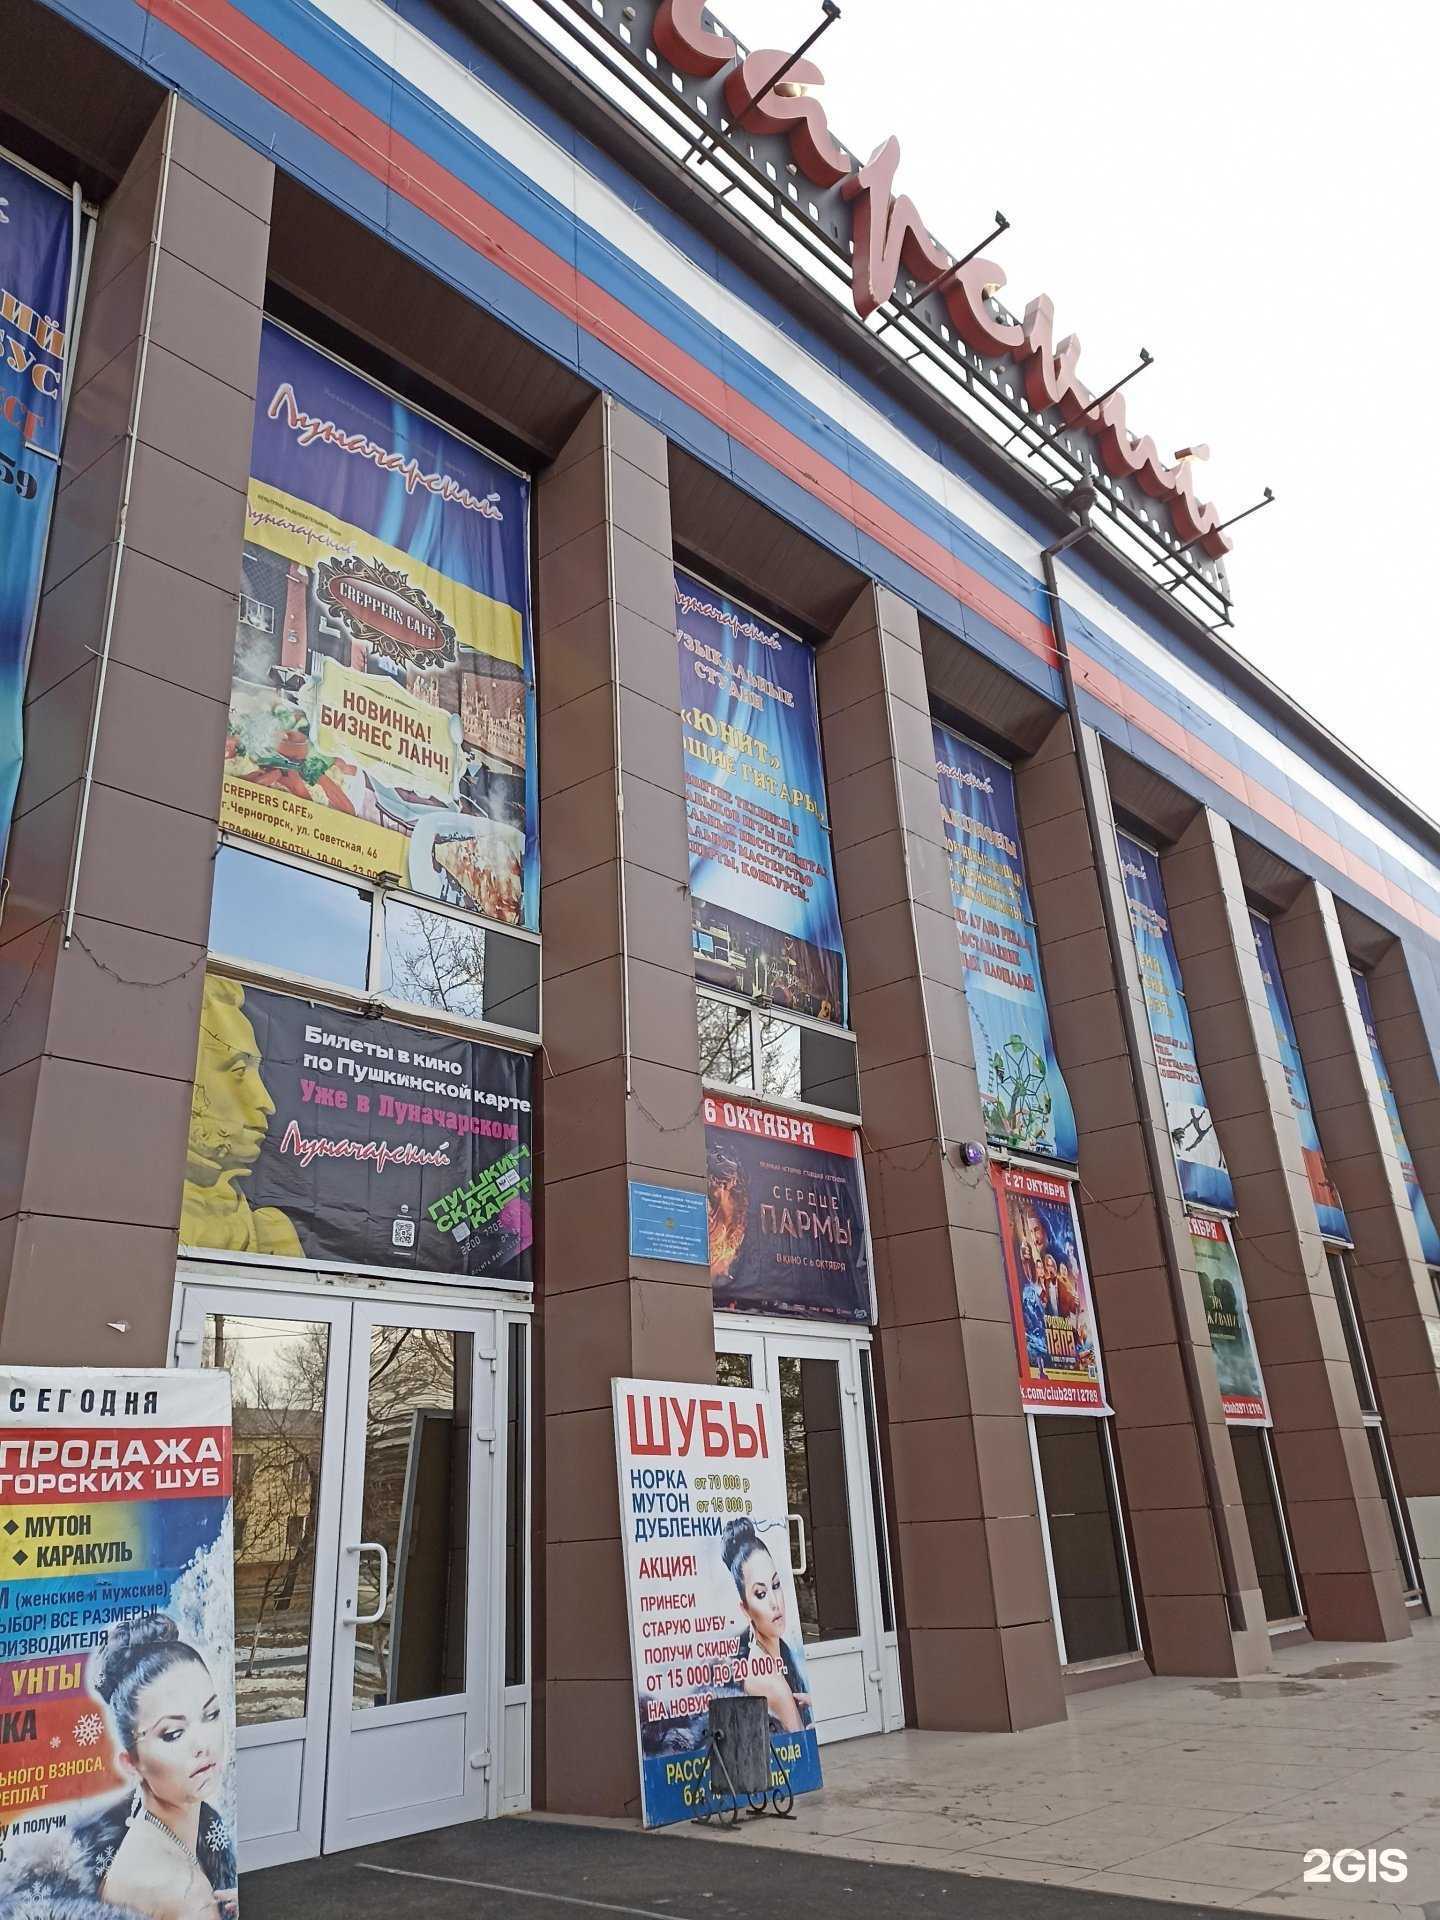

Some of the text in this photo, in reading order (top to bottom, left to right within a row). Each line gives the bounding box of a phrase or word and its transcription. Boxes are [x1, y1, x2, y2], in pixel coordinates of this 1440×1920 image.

[0, 328, 61, 400] УС
[267, 382, 503, 520] Луначарский
[340, 581, 436, 641] CREPPERS CAFE
[343, 689, 432, 744] НОВИНКА!
[321, 704, 450, 775] БИЗНЕС ЛАНЧ!
[683, 736, 736, 775] ЩИЕ
[223, 782, 314, 820] CREPPERS CAFE»
[296, 825, 310, 837] ул.
[313, 828, 364, 855] Советская,
[367, 847, 378, 859] 46
[304, 1024, 463, 1075] Билеты в кино
[303, 1053, 532, 1114] по Пушкинской карте
[300, 1078, 519, 1142] Уже в Луначарском
[704, 1098, 815, 1146] 6 ОКТЯБРЯ
[280, 1120, 450, 1173] Луначарский
[773, 1185, 840, 1210] СЕРДЦЕ
[1013, 1175, 1024, 1189] 27
[1026, 1178, 1066, 1198] ОКТЯБРЯ
[760, 1203, 852, 1247] ПАРМЫ
[10, 1388, 158, 1417] СЕГОДНЯ
[626, 1394, 769, 1459] ШУБЫ
[155, 1467, 220, 1489] ШУБ
[630, 1469, 687, 1489] НОРКА
[694, 1477, 707, 1490] от
[708, 1474, 721, 1490] 70
[723, 1474, 741, 1490] 000
[632, 1493, 690, 1513] МУТОН
[697, 1500, 709, 1513] от
[711, 1497, 724, 1512] 15
[725, 1497, 743, 1512] 000
[25, 1515, 91, 1538] МУТОН
[635, 1517, 723, 1543] ДУБЛЕНКИ
[36, 1541, 133, 1568] КАРАКУЛЬ
[639, 1555, 697, 1582] АКЦИЯ!
[16, 1590, 84, 1611] (женские
[88, 1590, 97, 1602] и
[640, 1593, 696, 1612] ПРИНЕСИ
[51, 1611, 78, 1629] ВСЕ
[642, 1618, 691, 1637] СТАРУЮ
[695, 1616, 726, 1632] ШУБУ
[644, 1637, 740, 1665] ПОЛУЧИ СКИДКУ
[11, 1662, 82, 1697] УНТЫ
[646, 1673, 663, 1692] ОТ
[667, 1669, 684, 1689] 15
[687, 1664, 710, 1685] 000
[733, 1658, 749, 1681] 20
[751, 1655, 773, 1676] 000
[648, 1700, 668, 1722] НА
[0, 1709, 37, 1745] КА
[49, 1756, 105, 1779] ВЗНОСА,
[12, 1823, 20, 1836] и
[23, 1815, 67, 1834] получи
